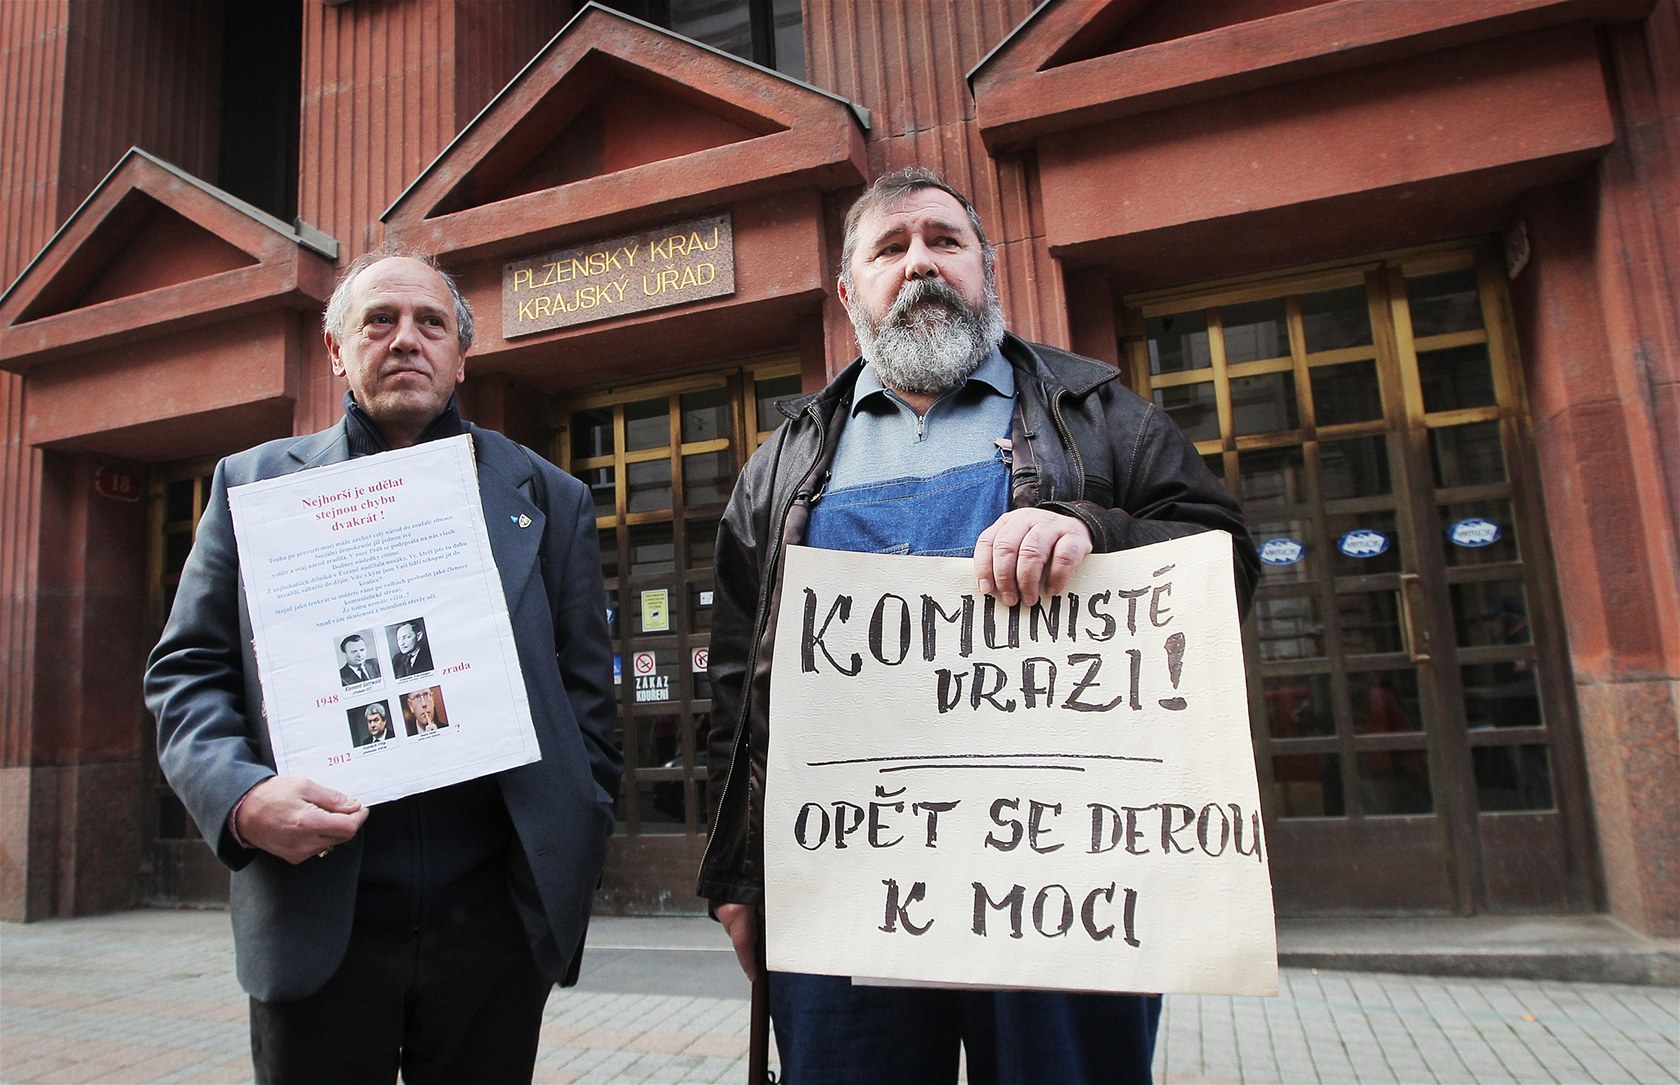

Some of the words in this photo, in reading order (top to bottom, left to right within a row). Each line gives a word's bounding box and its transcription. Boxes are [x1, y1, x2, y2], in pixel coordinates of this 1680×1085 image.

[513, 239, 639, 292] PLZEŇSKÝ
[650, 227, 720, 262] KRAJ
[518, 274, 630, 322] KRAJSKÝ
[642, 262, 716, 296] ÚŘAD
[302, 490, 352, 509] Nejhorší
[354, 486, 365, 498] je
[368, 477, 404, 493] udělat
[315, 504, 358, 520] stejnou
[360, 495, 396, 510] chybu
[331, 513, 377, 531] dvakrát
[380, 510, 385, 519] !
[385, 526, 402, 535] národ
[293, 603, 307, 611] jako
[432, 569, 446, 577] jako
[801, 564, 1177, 677] KOMUNISTÉ
[441, 661, 470, 675] zrada
[935, 631, 1188, 713] VRAZI!
[314, 694, 339, 707] 1948
[454, 723, 461, 733] ?
[326, 752, 352, 766] 2012
[794, 785, 960, 851] OPĚT
[985, 798, 1064, 854] SE
[1086, 802, 1263, 862] DEROU
[877, 878, 935, 936] K
[972, 881, 1141, 948] MOCI
